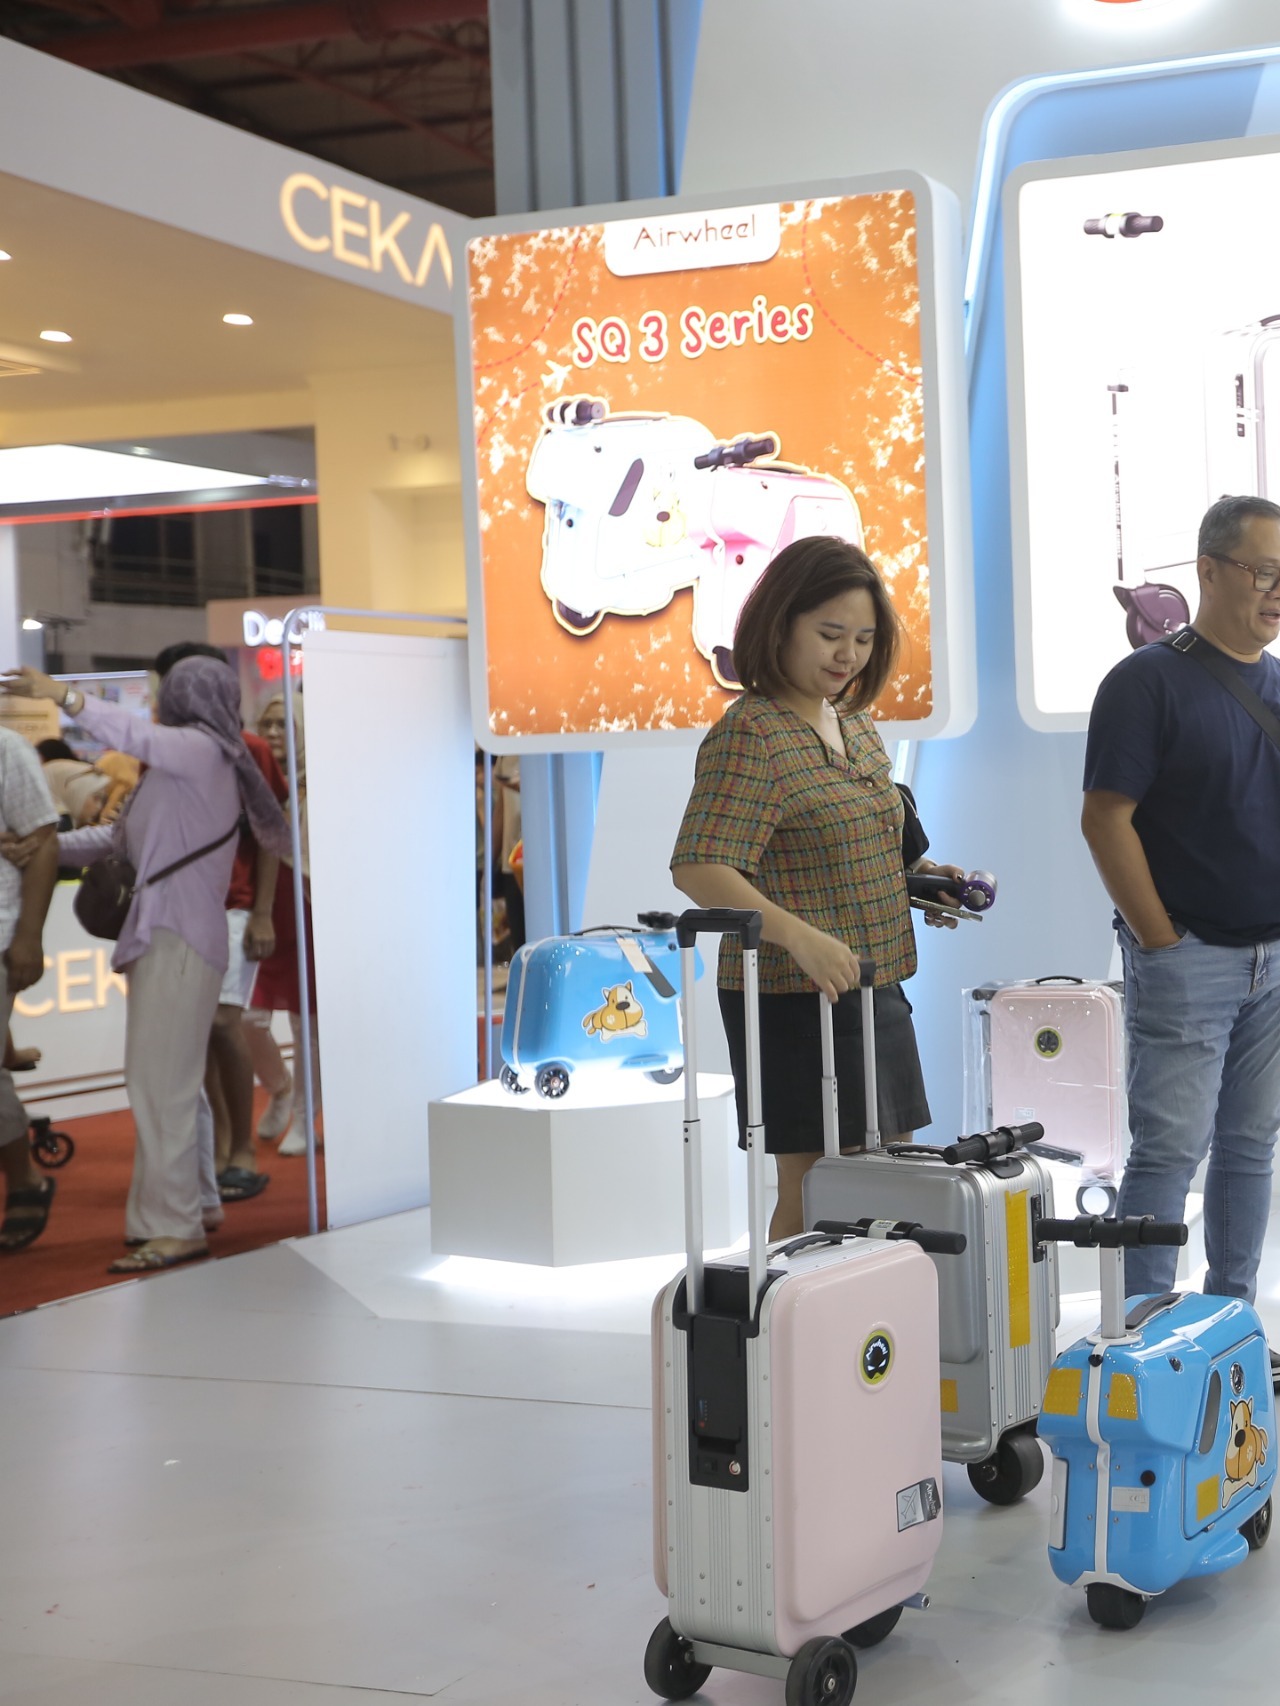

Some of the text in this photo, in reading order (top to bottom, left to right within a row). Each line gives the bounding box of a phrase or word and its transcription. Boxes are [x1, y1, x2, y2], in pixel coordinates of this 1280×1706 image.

[632, 213, 757, 250] Airwheel
[574, 297, 812, 365] SQ 3 Series
